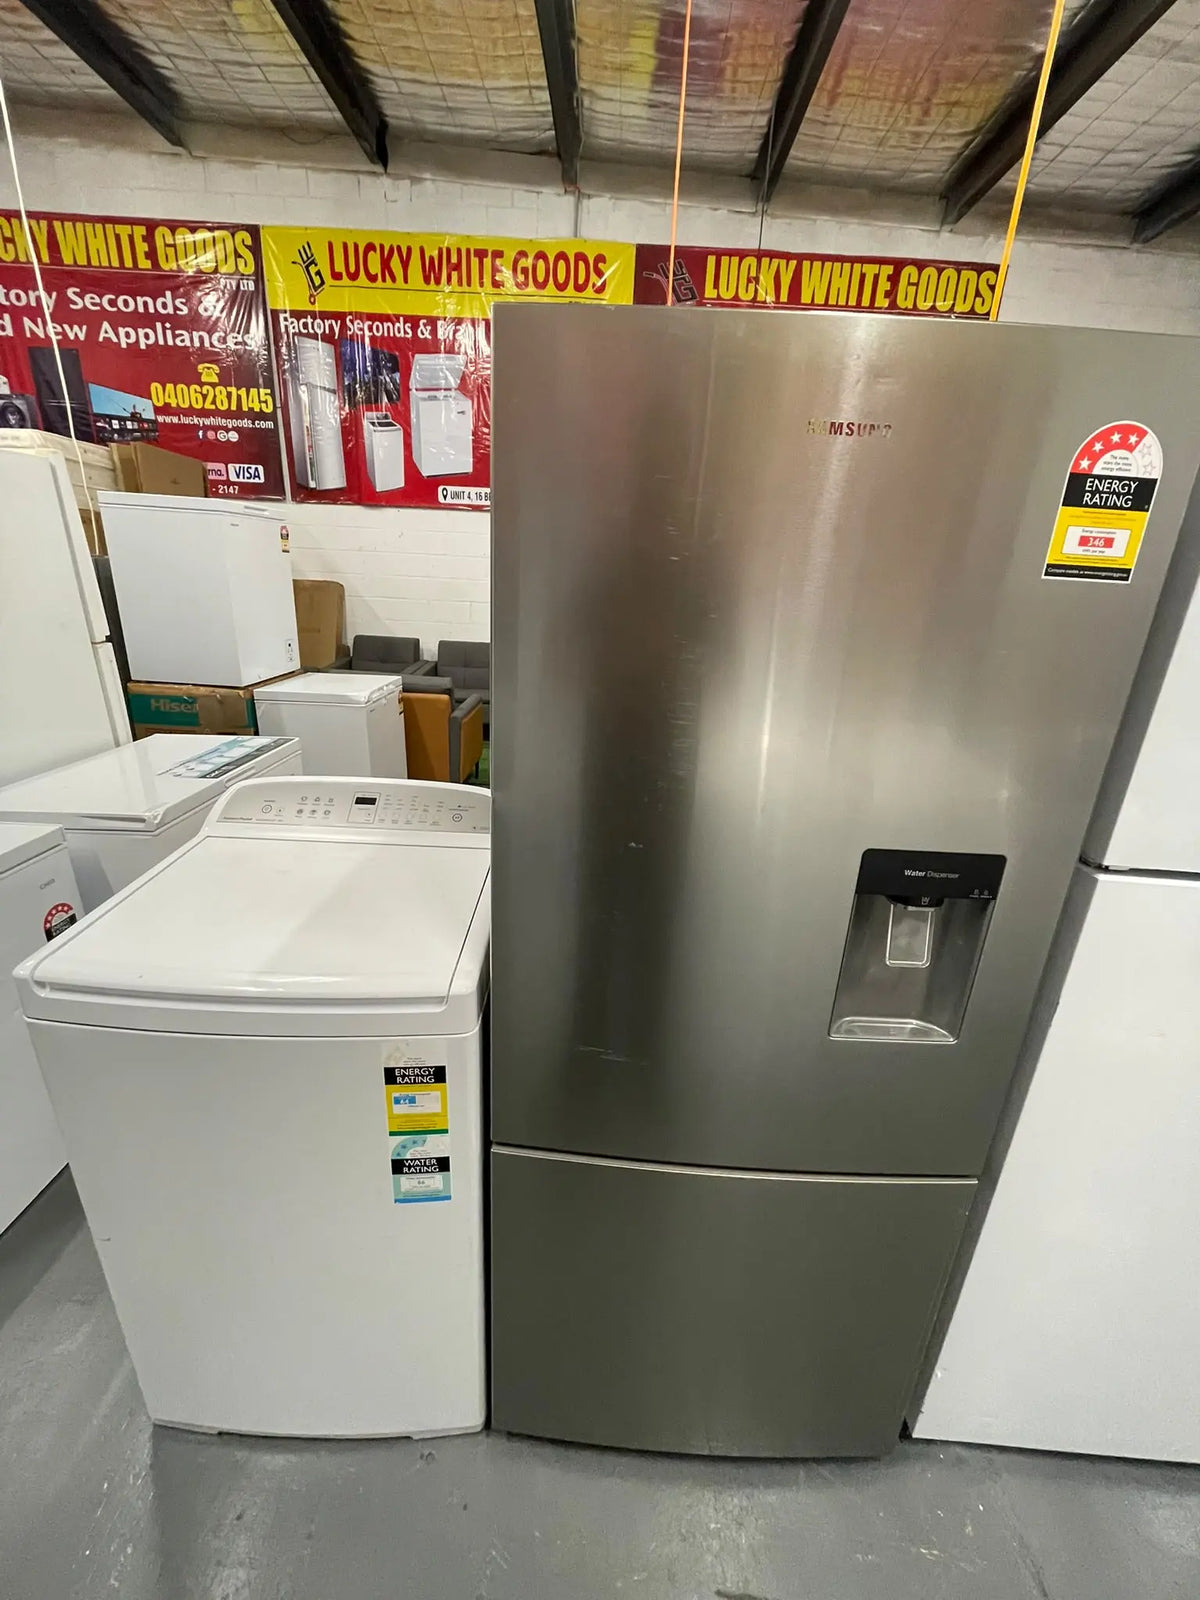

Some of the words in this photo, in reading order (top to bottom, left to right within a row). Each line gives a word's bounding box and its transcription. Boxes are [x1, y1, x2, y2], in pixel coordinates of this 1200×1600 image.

[53, 220, 152, 270] WHITE
[154, 225, 256, 275] GOODS
[327, 240, 412, 284] LUCKY
[419, 245, 506, 290] WHITE
[512, 249, 608, 295] GOODS
[704, 254, 797, 304] LUCKY
[801, 259, 895, 309] WHITE
[896, 264, 996, 315] GOODS
[67, 286, 188, 316] Seconds
[198, 291, 225, 317] &
[22, 316, 88, 342] New
[99, 320, 254, 351] Appliances
[279, 313, 341, 339] Factory
[346, 315, 412, 338] Seconds
[417, 319, 432, 339] &
[150, 381, 274, 413] 0406287145
[156, 414, 275, 431] www.luckywhitegoods.com
[232, 465, 262, 481] VISA
[218, 484, 239, 495] 2147
[1085, 478, 1138, 494] ENERGY
[450, 490, 466, 501] UNIT
[475, 491, 483, 502] 16
[1082, 492, 1133, 508] RATING
[1087, 537, 1105, 547] 346
[904, 869, 926, 877] Water
[927, 870, 960, 879] Dispenser
[394, 1067, 435, 1076] ENERGY
[396, 1075, 435, 1084] RATING
[402, 1165, 439, 1174] RATING
[403, 1158, 437, 1166] WATER
